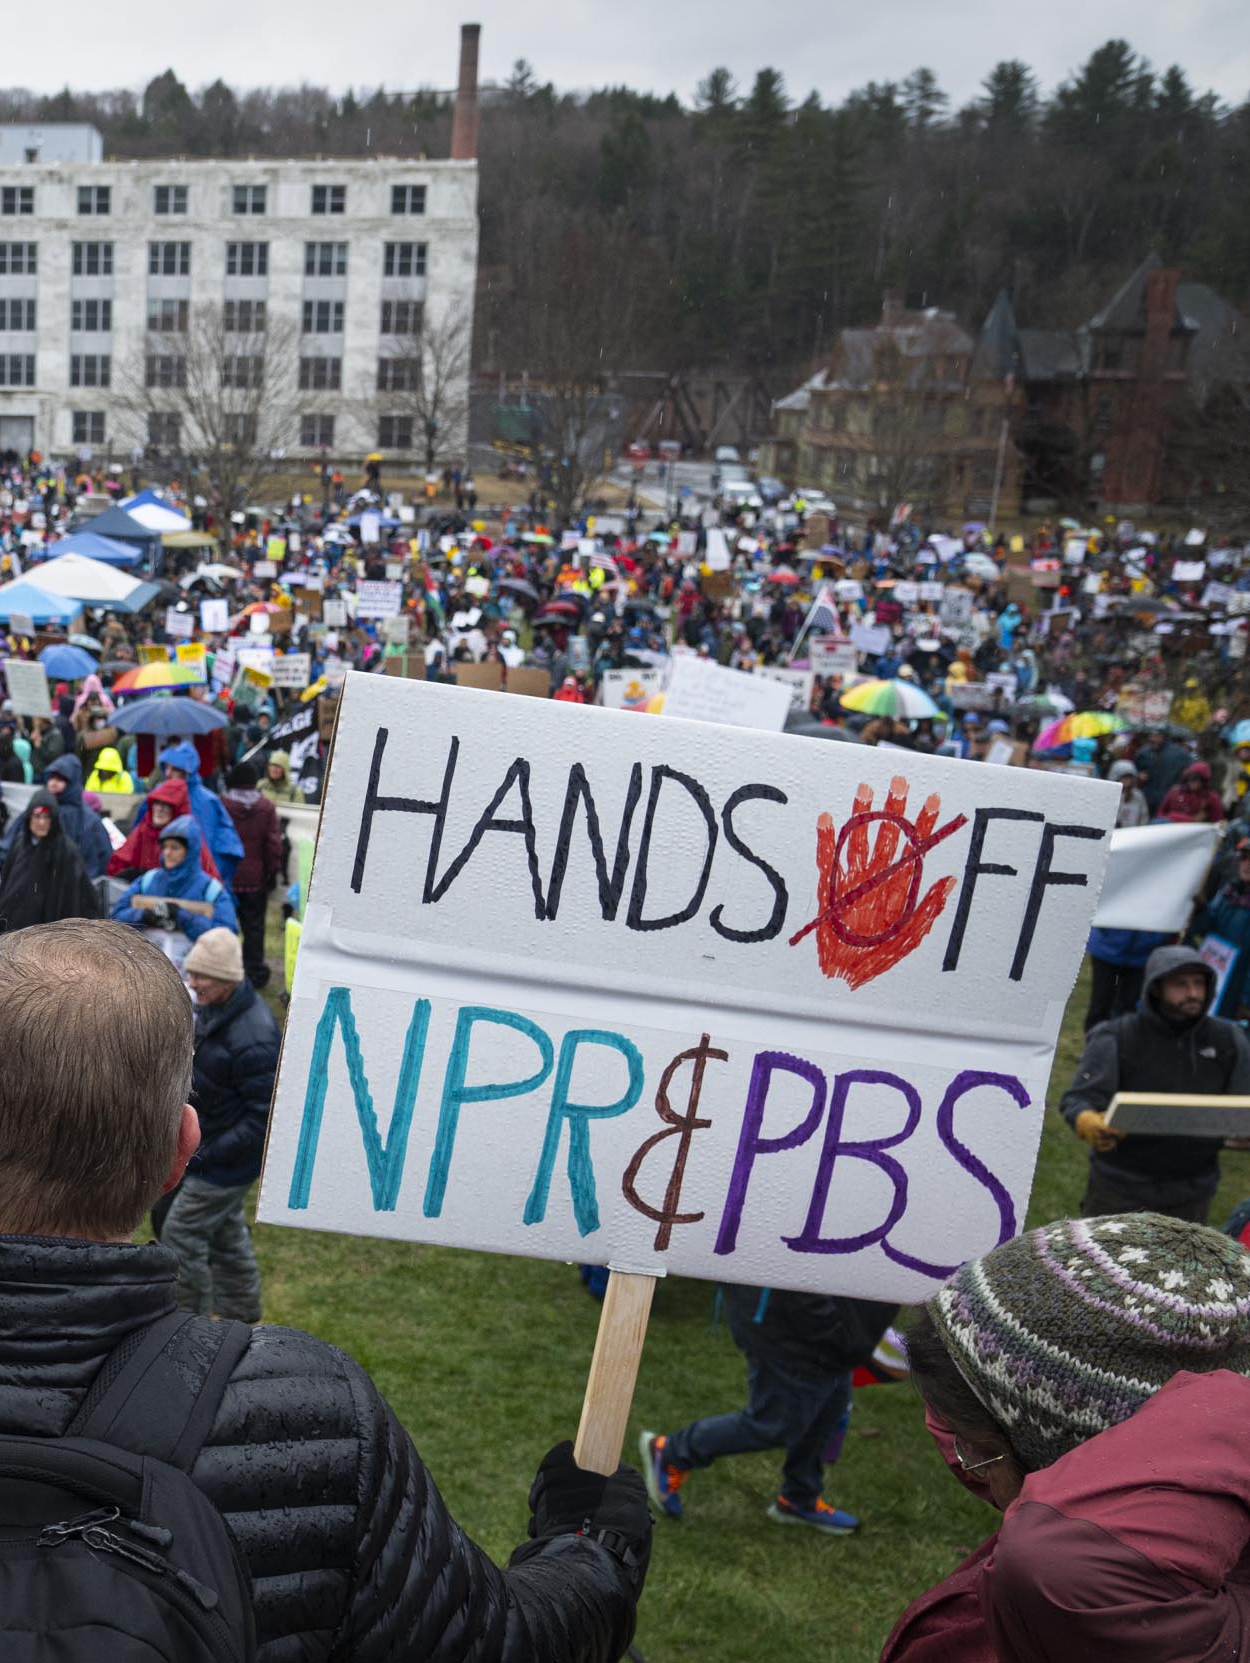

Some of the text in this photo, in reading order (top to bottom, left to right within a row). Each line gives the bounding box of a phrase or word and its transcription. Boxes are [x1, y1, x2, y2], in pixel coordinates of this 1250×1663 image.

[351, 728, 788, 943] HANDS
[288, 987, 645, 1236] NPR
[715, 1052, 1030, 1278] PBS
